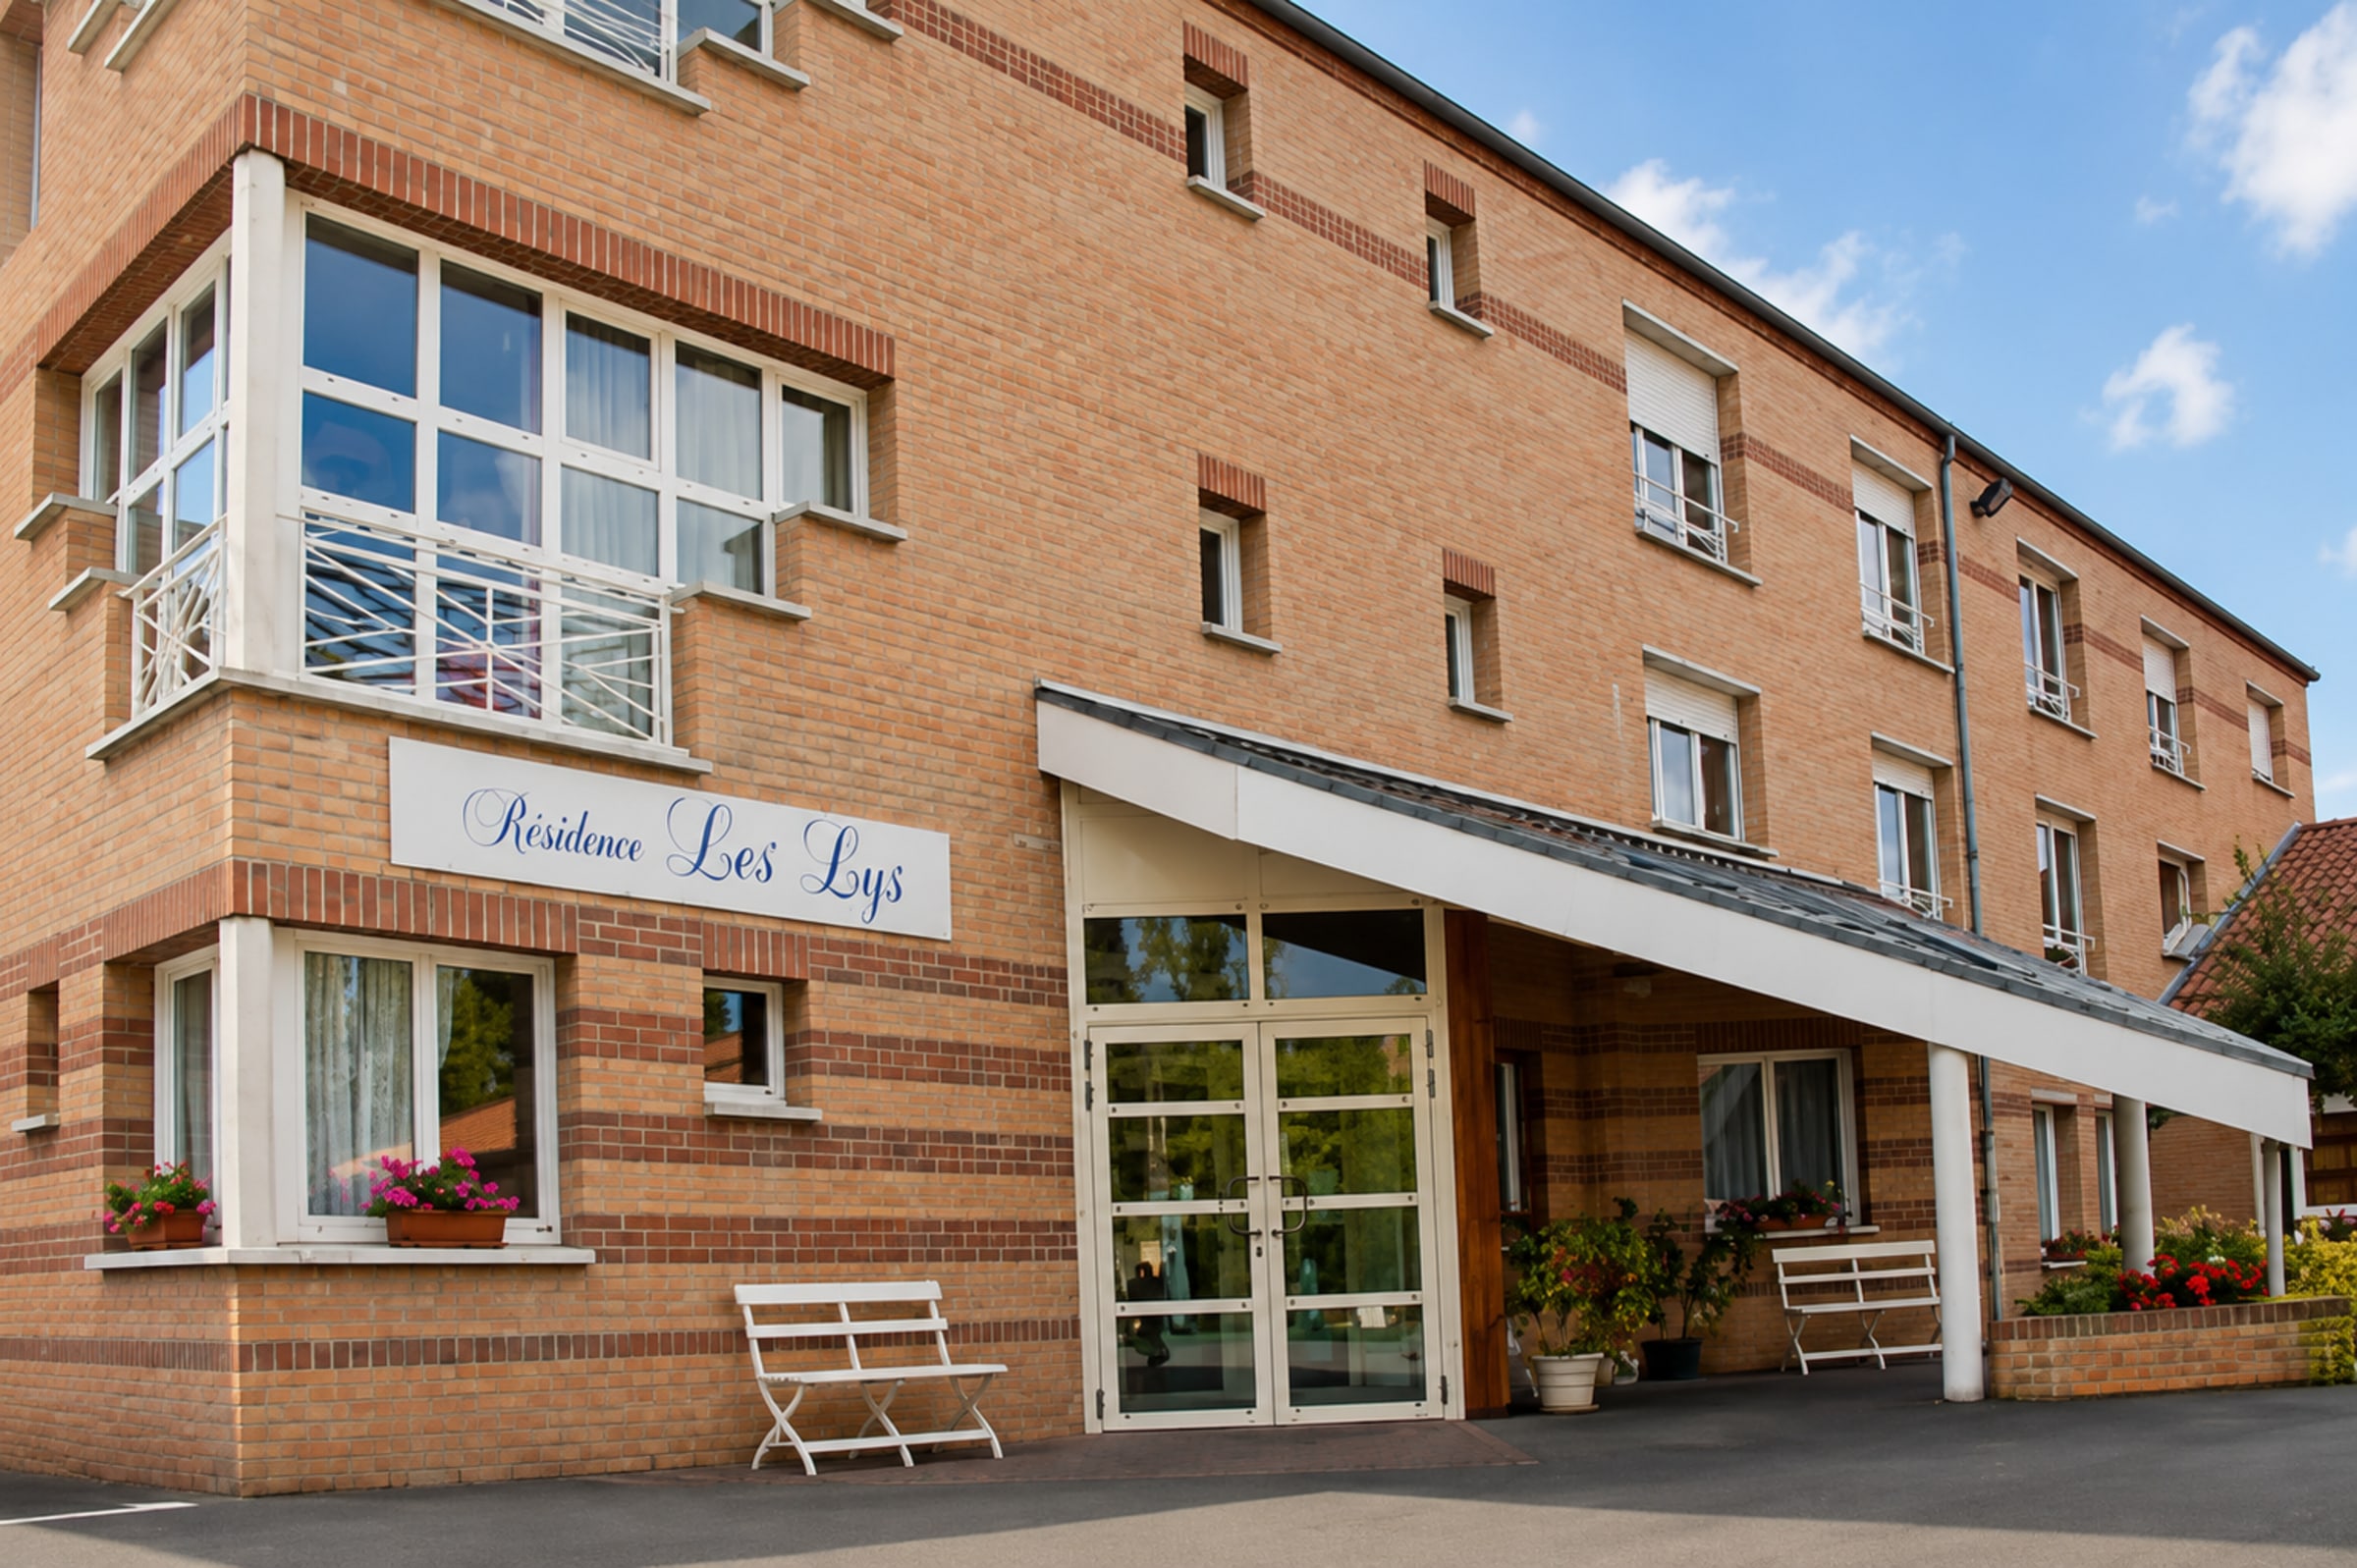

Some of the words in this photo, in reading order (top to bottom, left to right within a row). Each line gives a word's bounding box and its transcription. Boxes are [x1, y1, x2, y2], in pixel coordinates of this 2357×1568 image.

[463, 788, 644, 861] Résidence
[666, 797, 777, 884] Les
[800, 819, 903, 924] Lys
